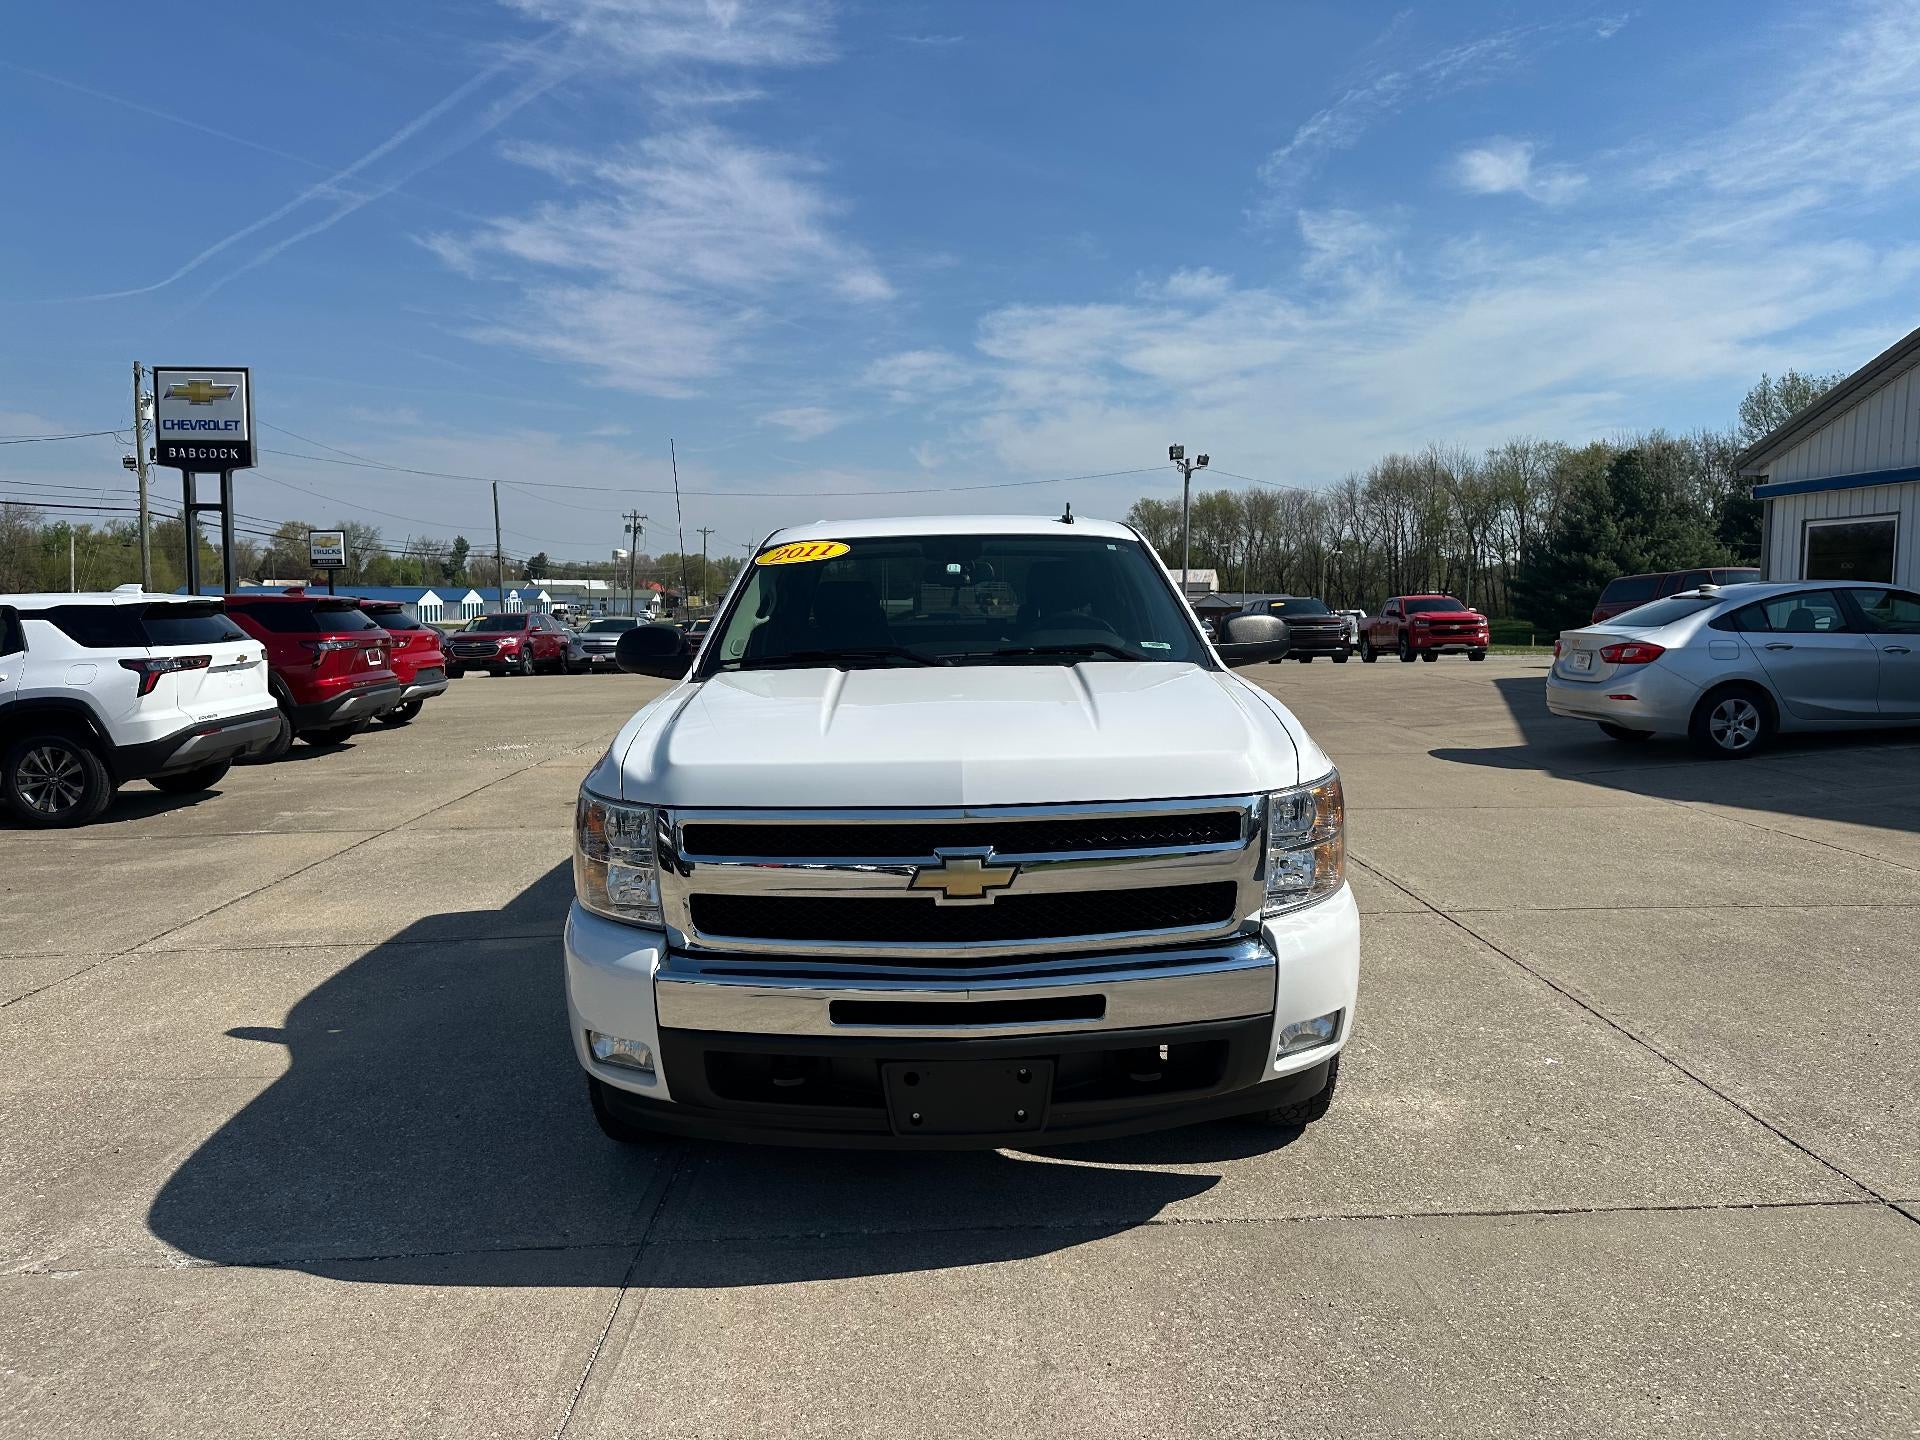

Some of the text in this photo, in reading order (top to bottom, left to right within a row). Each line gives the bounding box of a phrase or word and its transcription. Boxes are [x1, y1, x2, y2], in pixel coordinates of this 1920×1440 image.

[163, 419, 240, 431] CHEVROLET
[168, 447, 239, 459] BABCOCK
[769, 544, 836, 562] 2011
